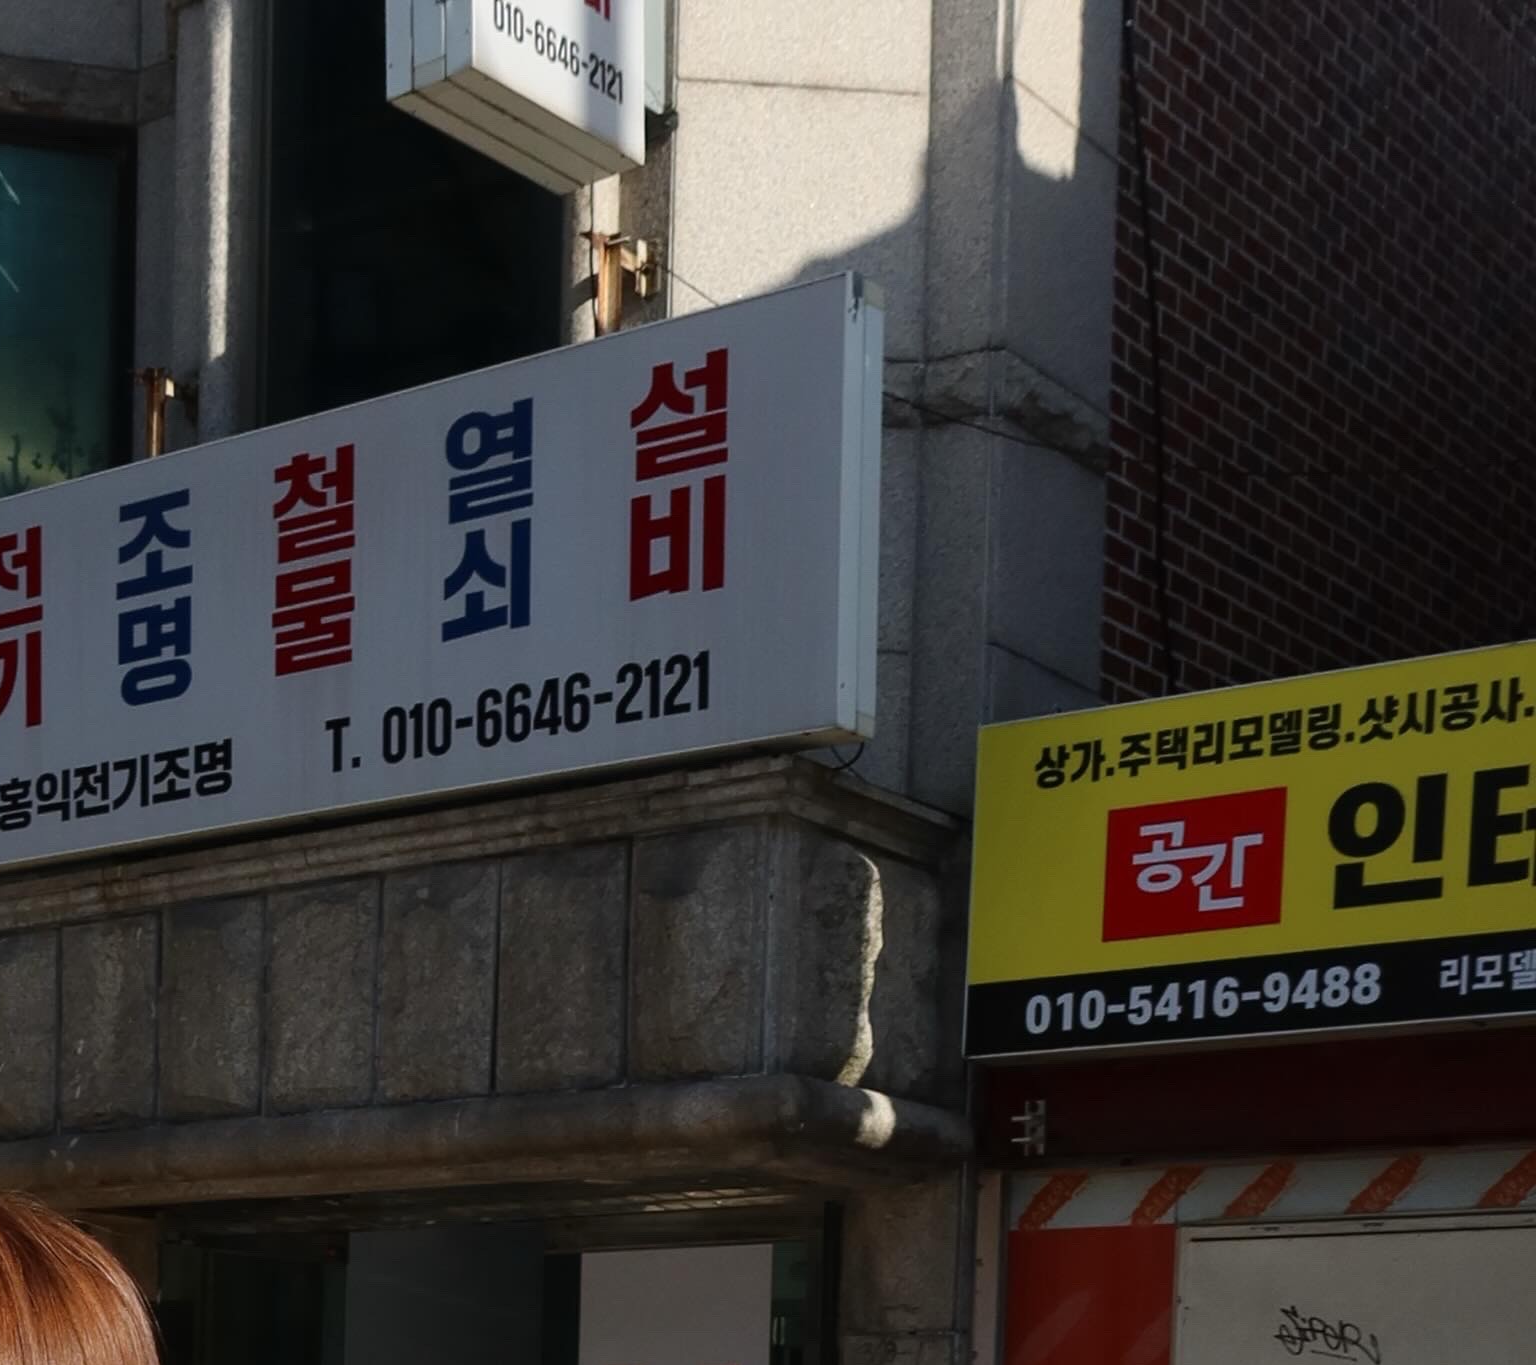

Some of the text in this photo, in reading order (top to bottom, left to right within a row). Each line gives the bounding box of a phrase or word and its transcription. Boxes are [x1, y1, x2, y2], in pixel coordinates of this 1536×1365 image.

[493, 0, 624, 104] 010-6646-2121
[271, 443, 356, 677] 철물
[441, 397, 534, 643] 열쇠
[629, 348, 729, 602] 설비
[115, 488, 193, 707] 조명
[324, 650, 711, 773] T. 010-6646-2121
[1132, 820, 1264, 912] 공간
[1025, 962, 1382, 1035] 010-5416-9488
